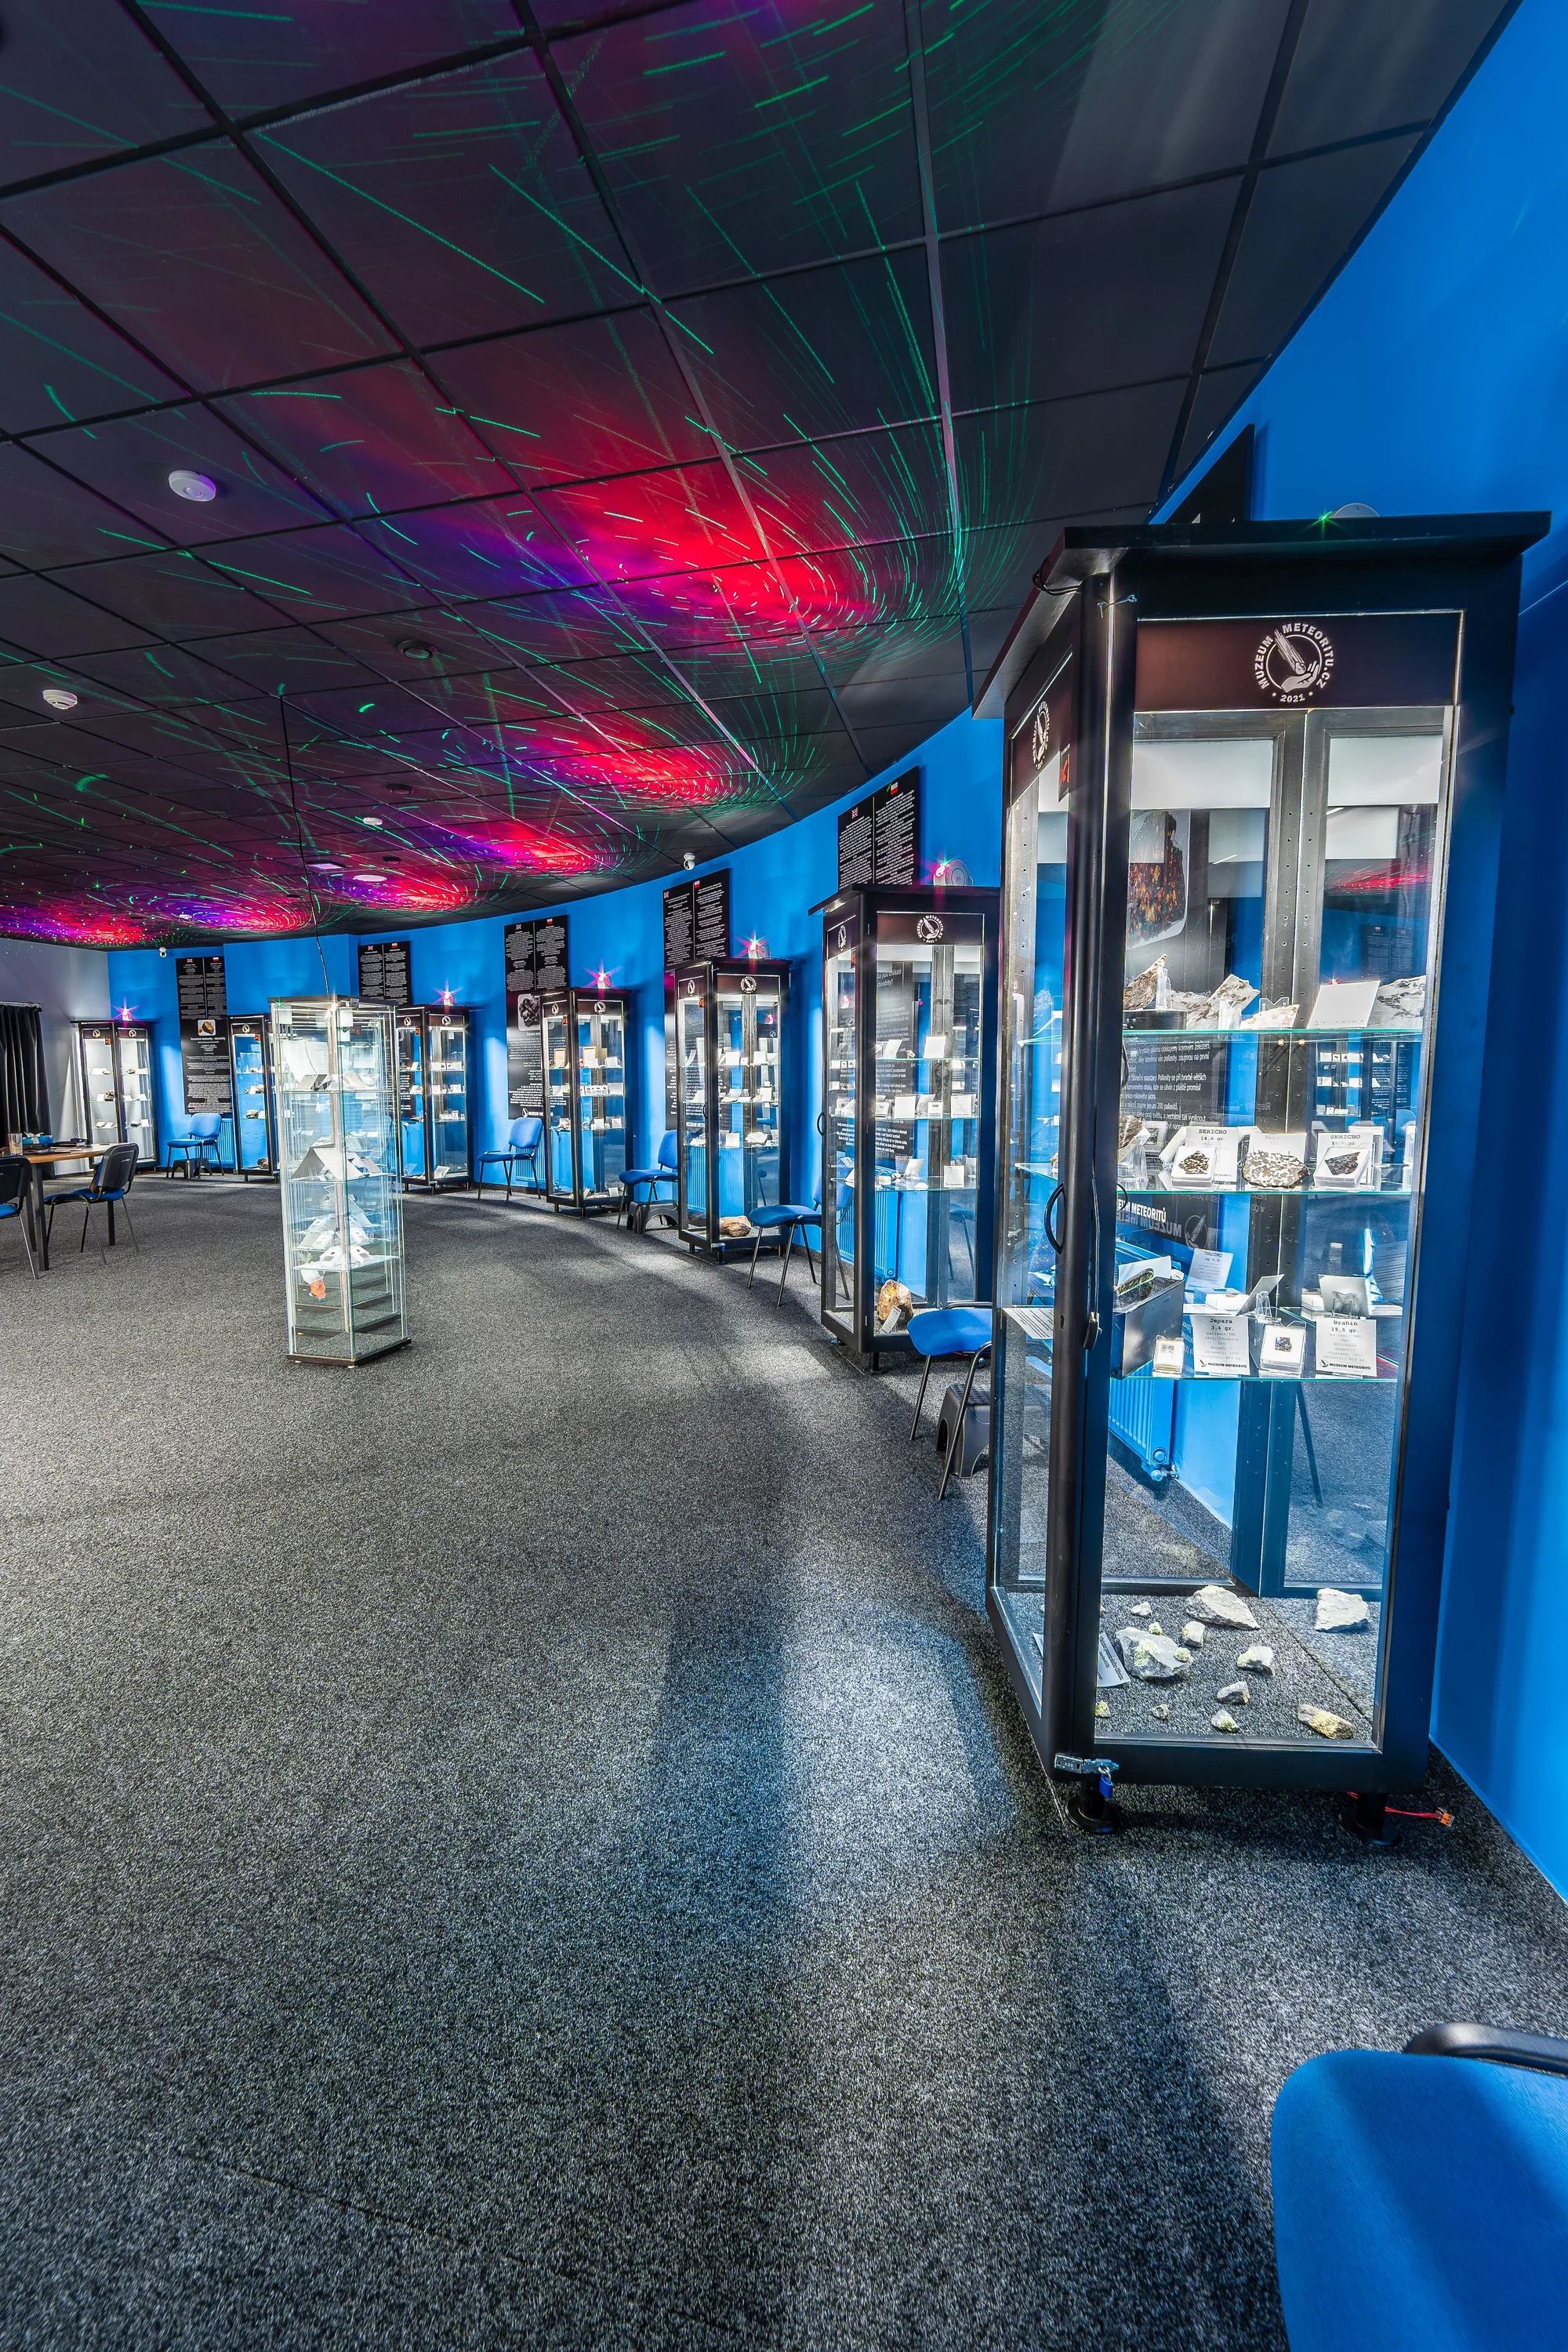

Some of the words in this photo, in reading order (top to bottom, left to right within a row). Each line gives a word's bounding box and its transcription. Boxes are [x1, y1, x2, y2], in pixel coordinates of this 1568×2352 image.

[1254, 635, 1274, 689] MUZEUM
[1282, 622, 1334, 689] METEORITU.CZ
[1279, 693, 1306, 703] 2021
[1131, 1202, 1167, 1223] METEORITŮ
